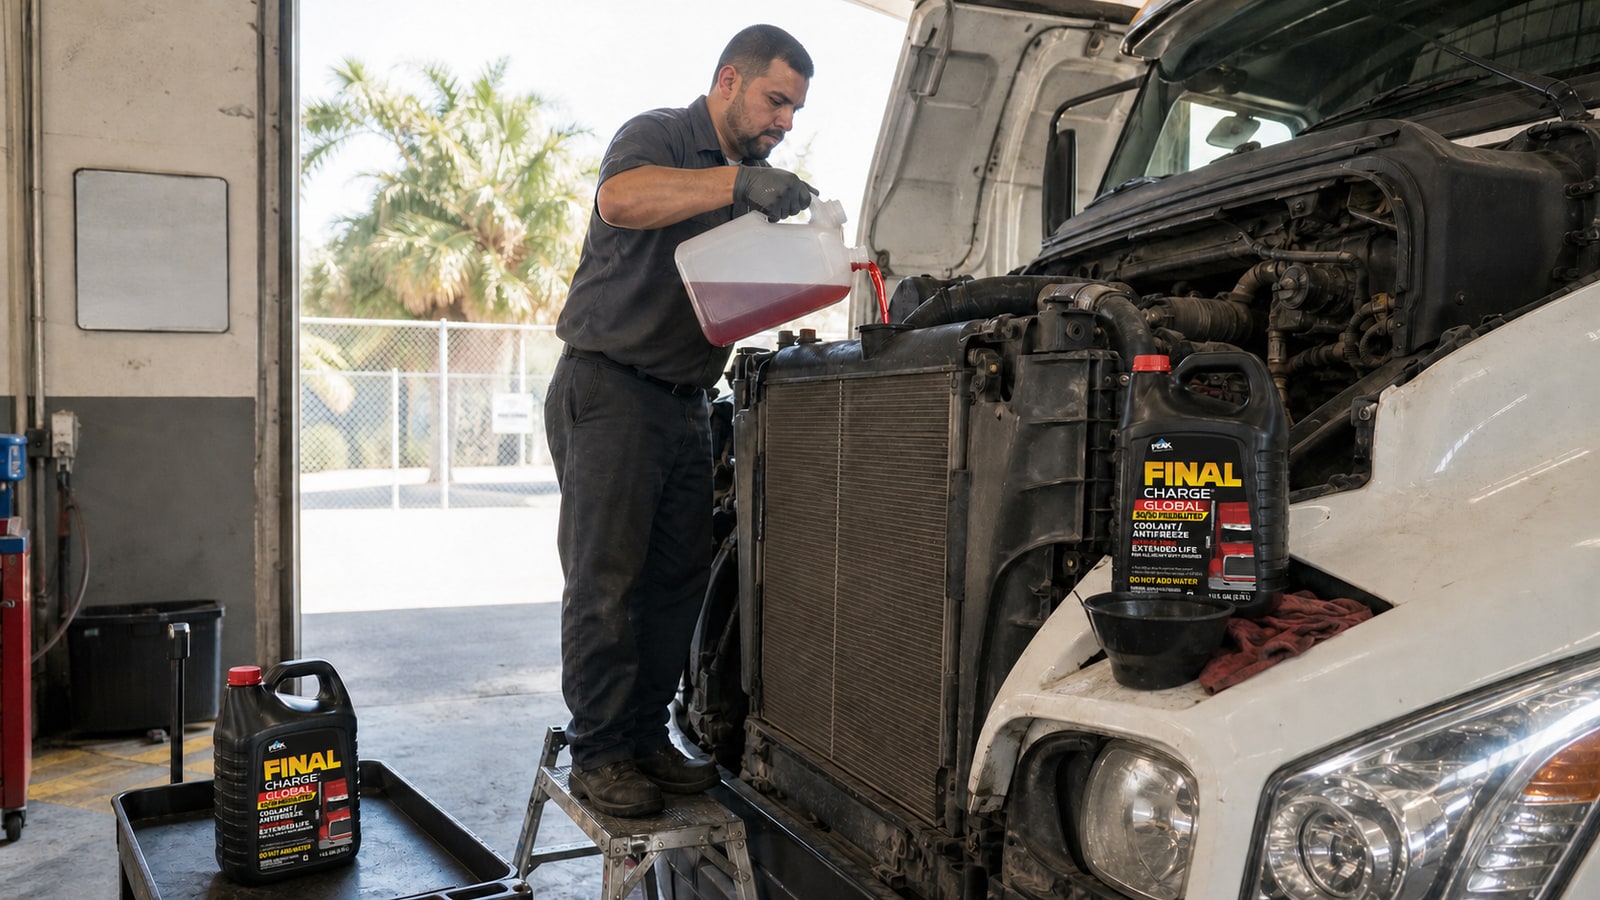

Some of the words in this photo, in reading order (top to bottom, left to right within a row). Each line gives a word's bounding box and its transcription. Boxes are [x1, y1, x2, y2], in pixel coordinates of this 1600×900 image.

[1151, 442, 1173, 450] PEAK
[1144, 461, 1242, 487] FINAL
[1144, 488, 1211, 499] CHARGE
[1143, 501, 1204, 511] GLOBAL
[1133, 522, 1176, 530] COOLANT
[1177, 522, 1183, 531] /
[1132, 530, 1190, 538] ANTIFREEZE
[1131, 545, 1177, 553] EXTENDED
[1178, 546, 1198, 554] LIFE
[1129, 576, 1140, 584] DO
[1156, 577, 1172, 585] ADD
[1172, 577, 1198, 585] WATER
[264, 750, 341, 781] FINAL
[265, 774, 318, 791] CHARGE
[266, 786, 312, 800] GLOBAL
